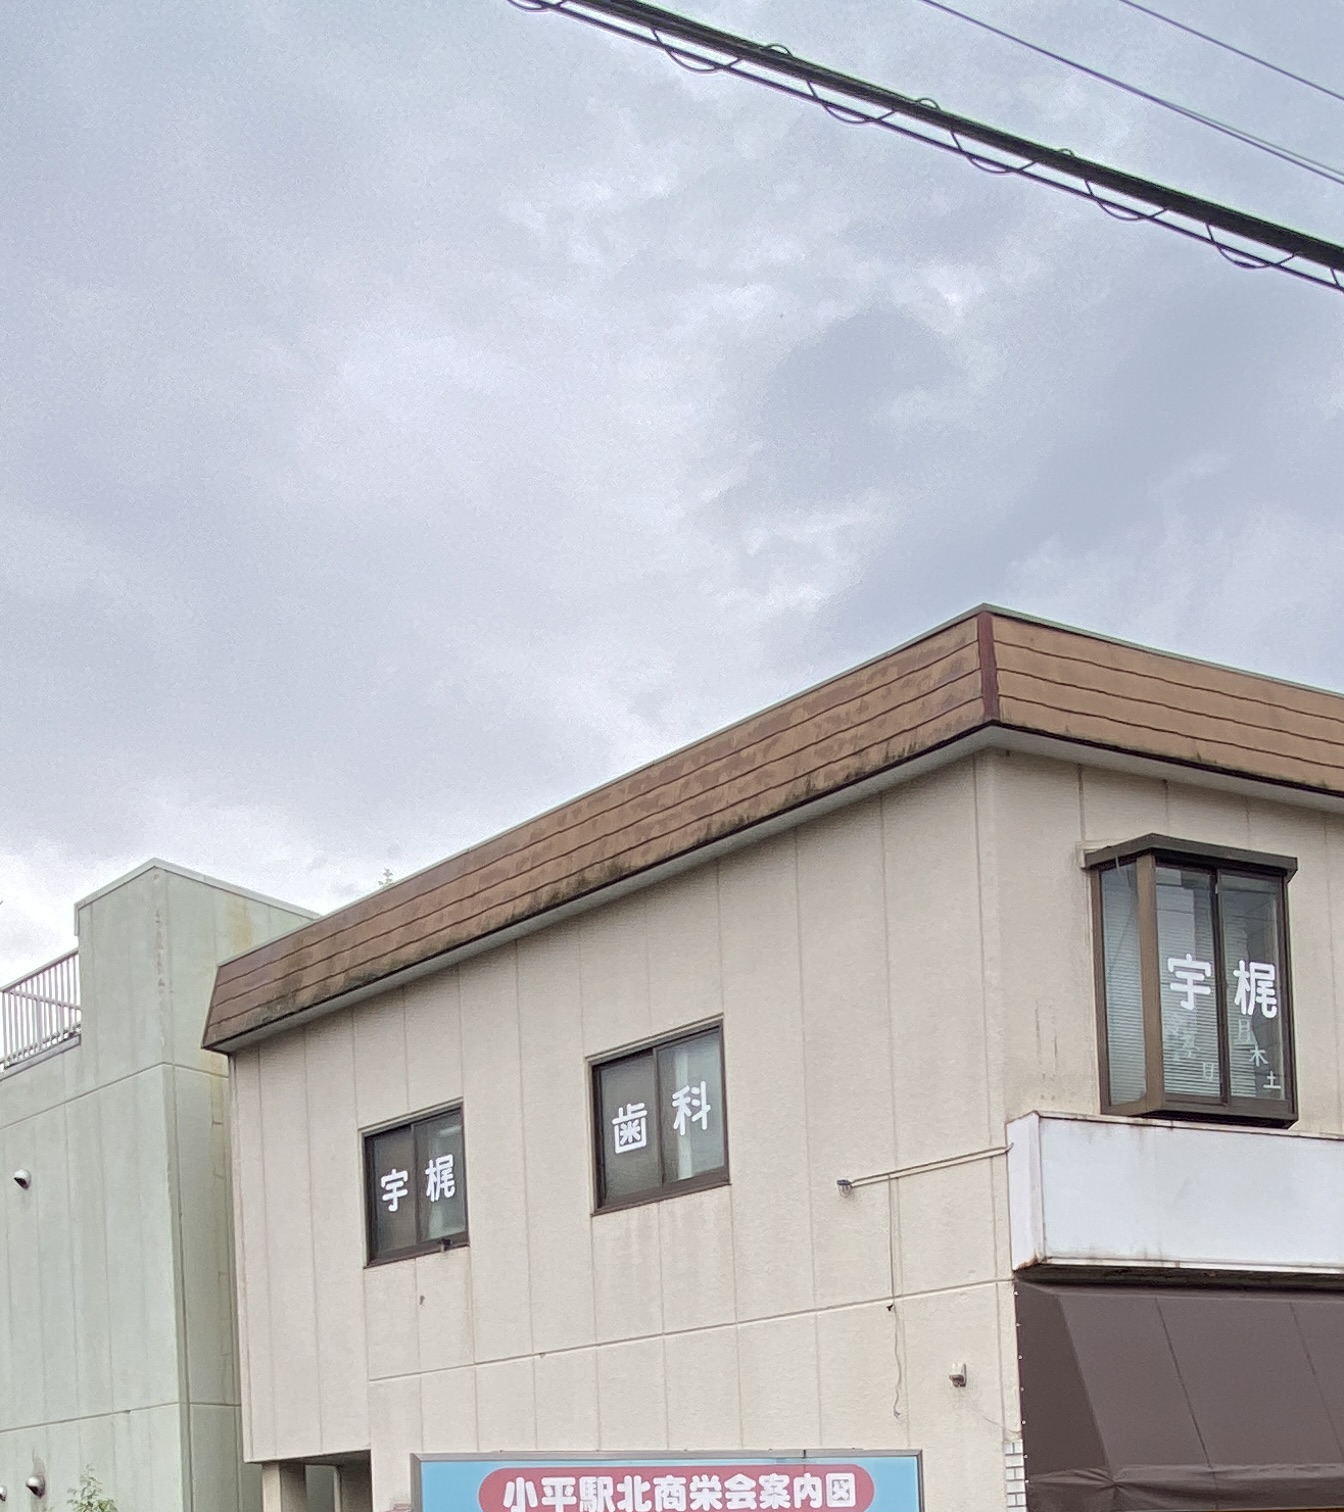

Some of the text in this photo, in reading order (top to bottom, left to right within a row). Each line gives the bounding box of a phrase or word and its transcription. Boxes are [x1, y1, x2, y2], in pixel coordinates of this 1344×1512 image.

[1167, 953, 1278, 1019] 宇梶
[380, 1081, 711, 1212] 宇梶 歯科
